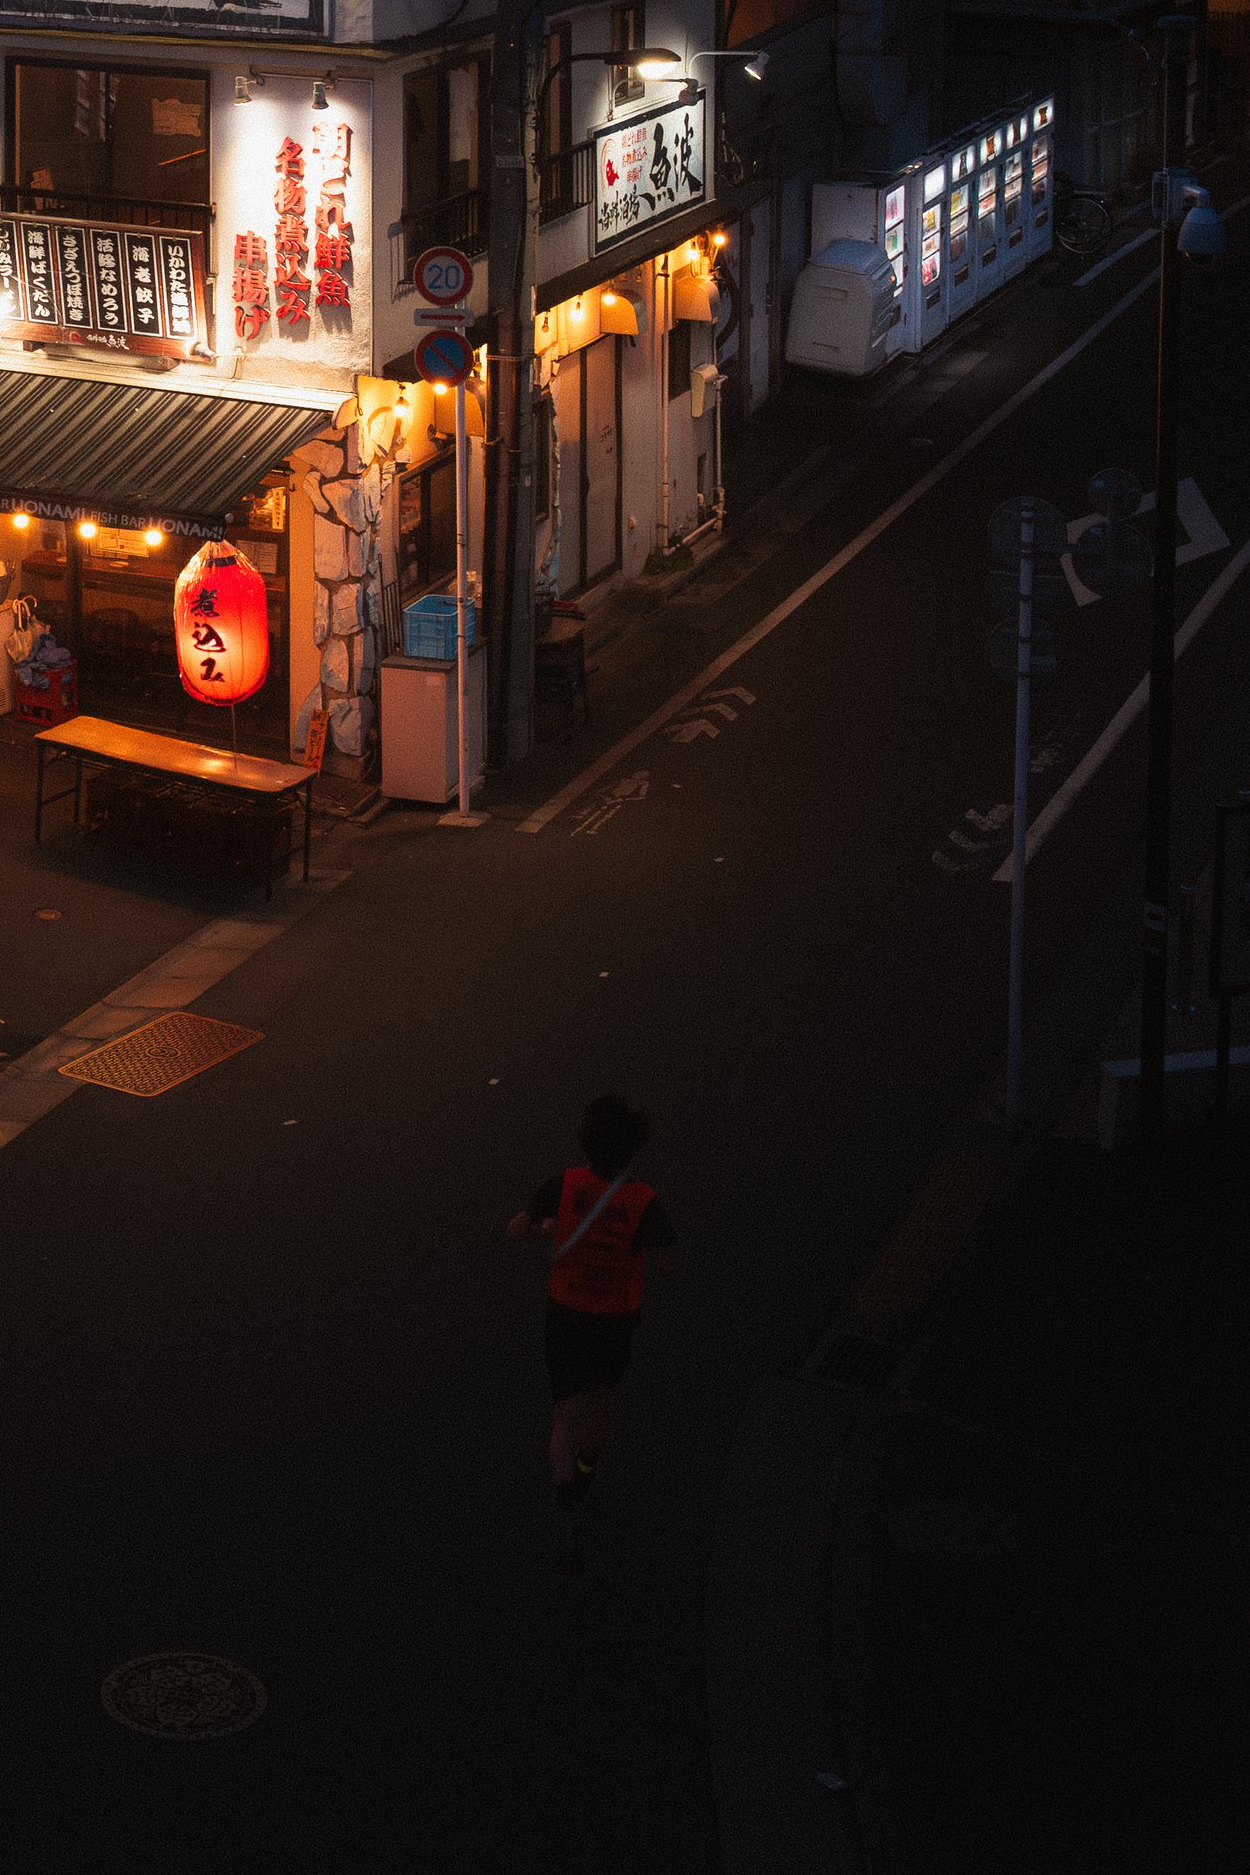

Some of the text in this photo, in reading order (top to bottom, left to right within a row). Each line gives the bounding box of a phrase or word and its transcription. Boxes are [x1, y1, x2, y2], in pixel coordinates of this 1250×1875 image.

[639, 113, 703, 211] 魚波
[273, 135, 312, 325] 名物煮込み
[598, 183, 640, 231] 海鮮酒場
[27, 230, 51, 318] 海鮮ばくだん
[132, 245, 155, 324] 海老餃子
[232, 230, 270, 341] 串揚げ
[428, 264, 459, 290] 20
[107, 334, 130, 350] 魚波
[11, 498, 86, 521] UONAMI
[90, 511, 118, 525] FISH
[121, 515, 147, 528] BAR
[190, 587, 228, 684] 煮込み
